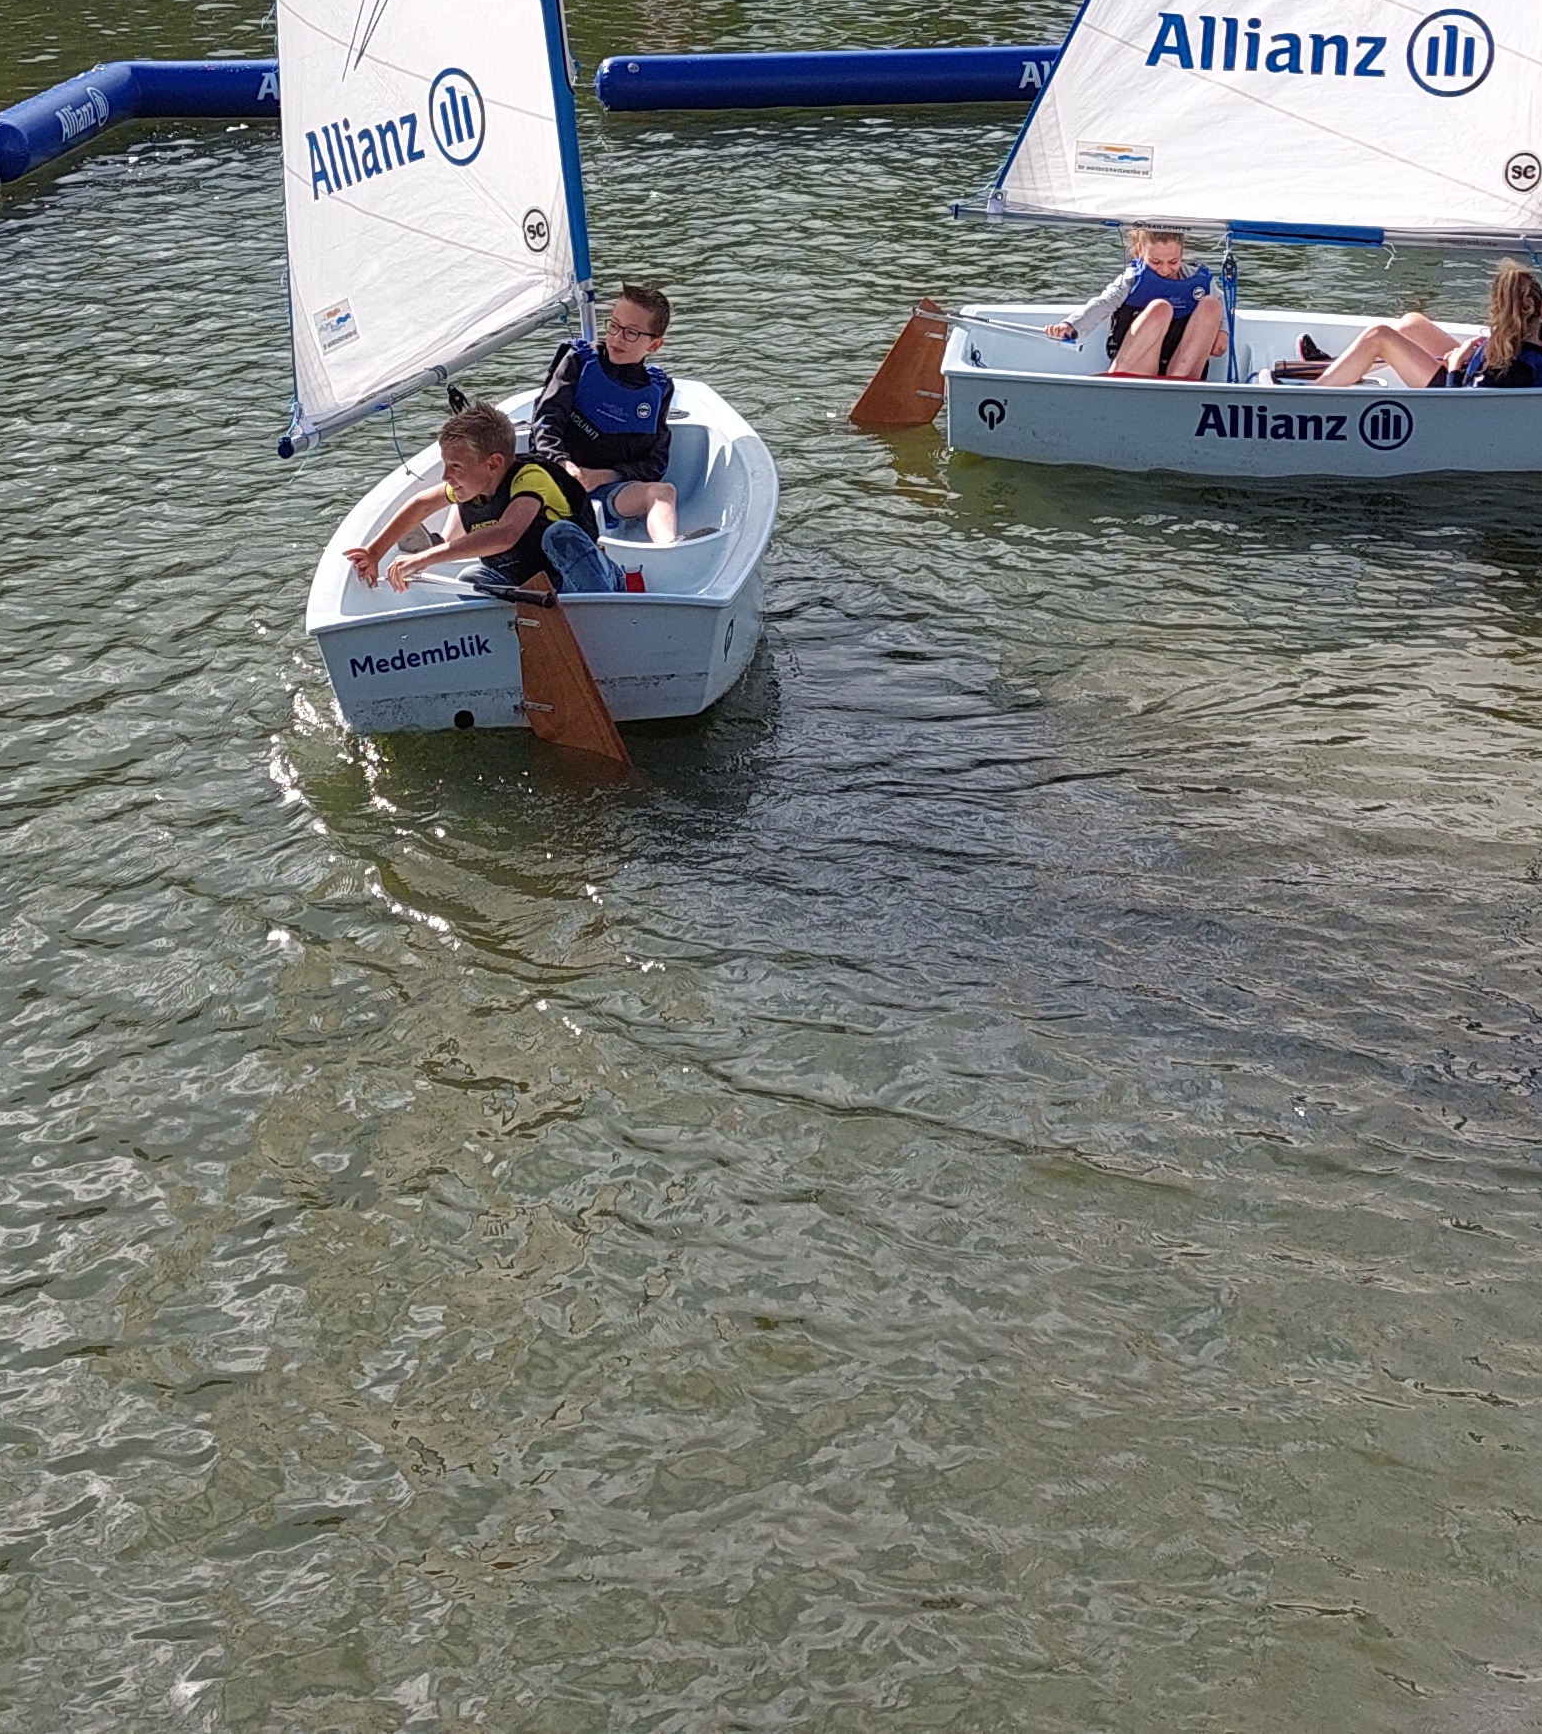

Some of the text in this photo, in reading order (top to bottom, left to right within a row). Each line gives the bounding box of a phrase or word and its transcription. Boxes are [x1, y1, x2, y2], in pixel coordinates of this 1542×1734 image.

[1144, 11, 1388, 78] Allianz
[55, 101, 97, 143] Allianz
[304, 112, 426, 202] Allianz
[1194, 403, 1348, 441] Allianz
[349, 634, 493, 679] Medemblik
